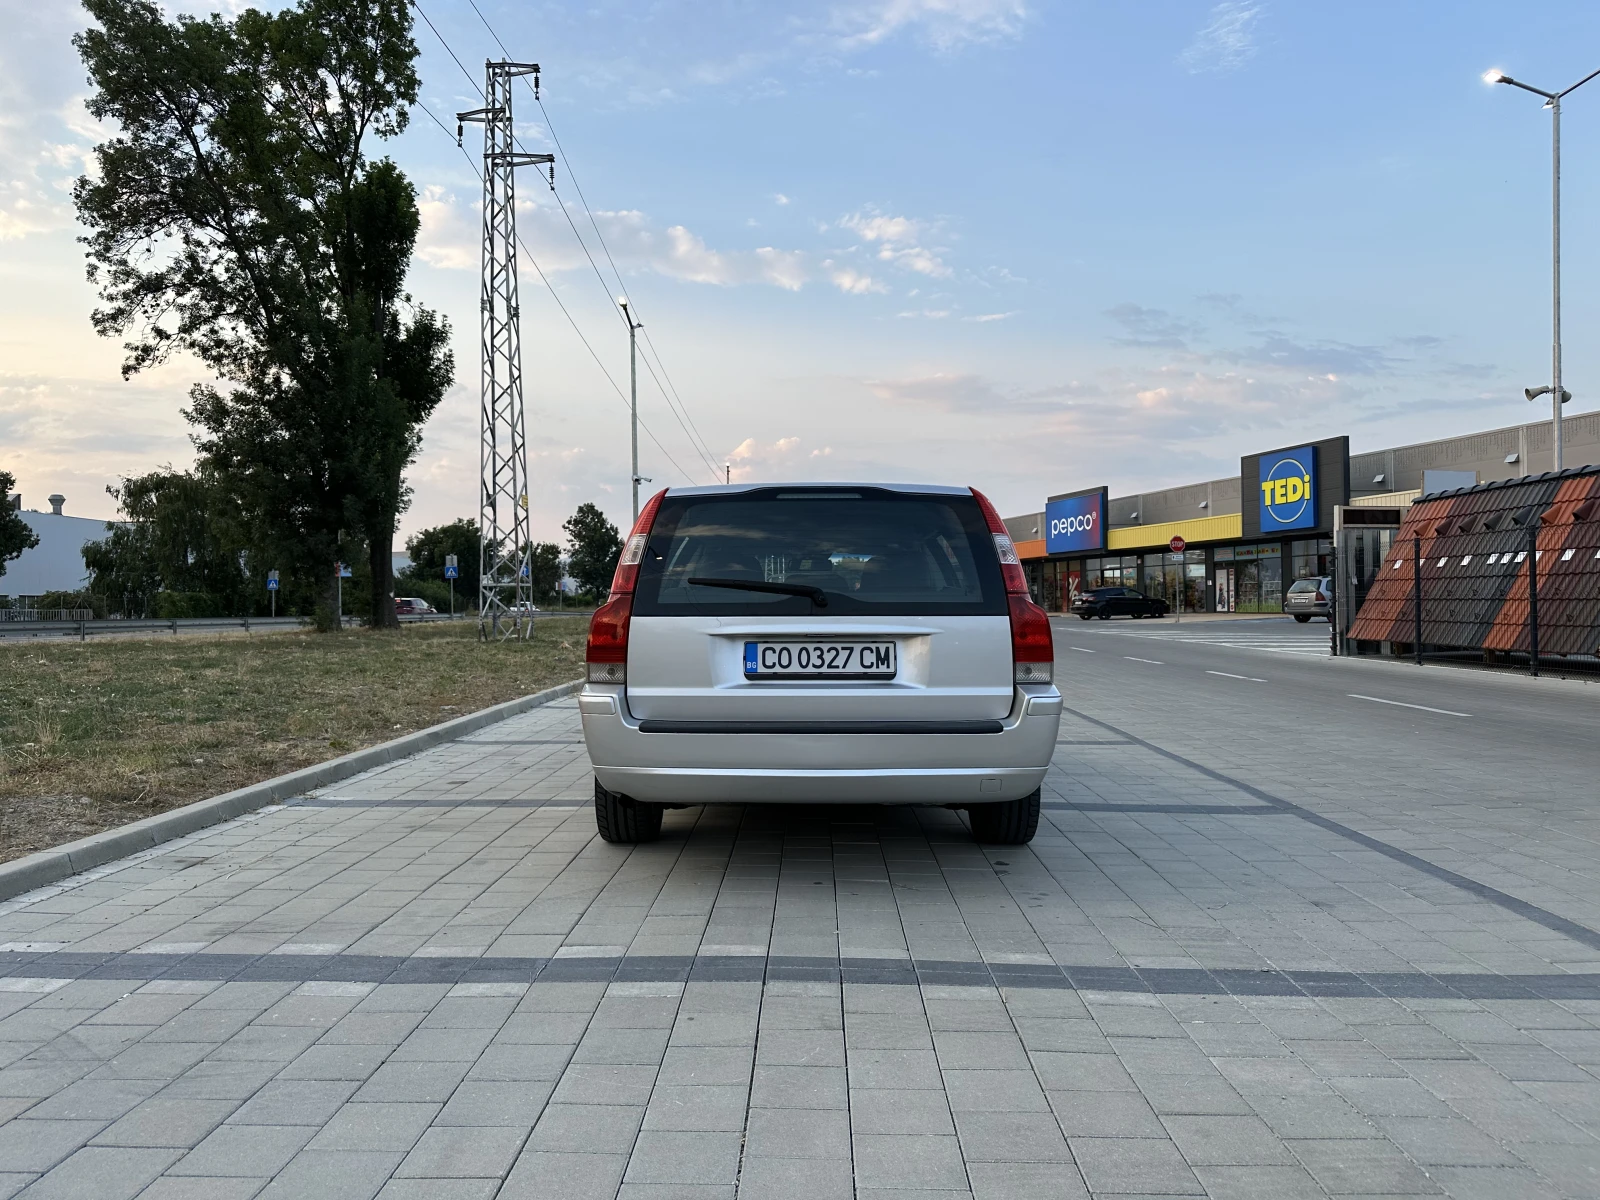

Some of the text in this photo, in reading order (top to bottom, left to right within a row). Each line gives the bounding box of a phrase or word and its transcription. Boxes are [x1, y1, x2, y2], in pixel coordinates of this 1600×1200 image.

[1261, 474, 1310, 506] TEDi
[1171, 540, 1184, 548] STOP
[746, 661, 757, 669] BG
[761, 646, 891, 669] CO 0327 CM
